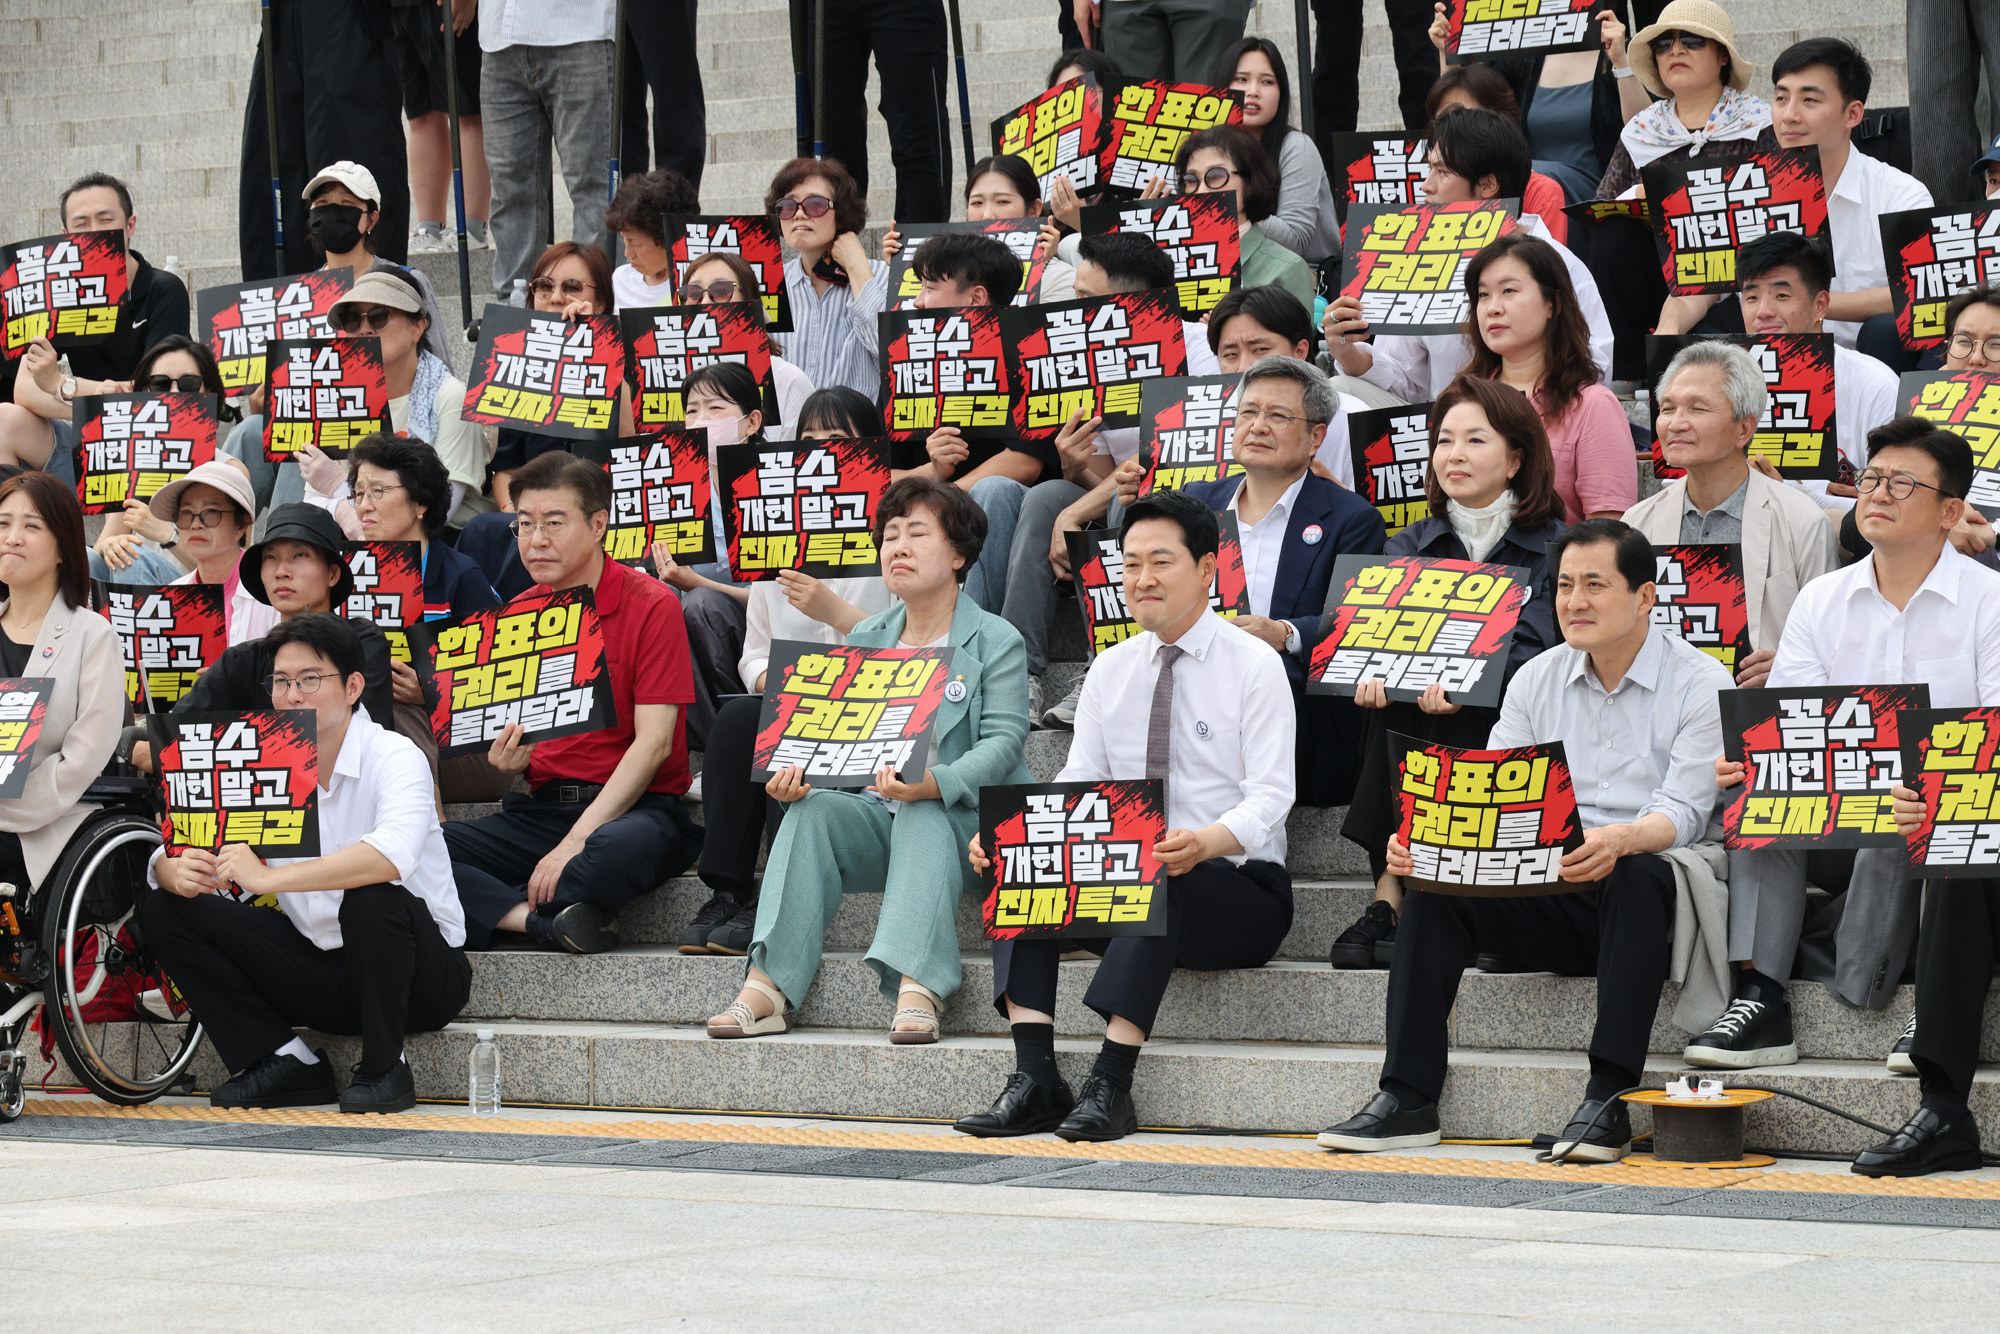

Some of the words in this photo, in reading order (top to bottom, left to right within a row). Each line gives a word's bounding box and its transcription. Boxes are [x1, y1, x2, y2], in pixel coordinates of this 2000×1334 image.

[1457, 12, 1589, 55] 돌려달라
[1002, 113, 1029, 156] 한
[1033, 84, 1085, 143] 표의
[1115, 85, 1156, 122] 한
[1156, 92, 1234, 130] 표의
[1117, 122, 1191, 163] 권리
[1110, 158, 1178, 194] 돌려
[1687, 162, 1769, 213] 꼼수
[1362, 213, 1418, 250] 한
[1418, 210, 1506, 251] 표의
[1670, 212, 1730, 249] 개헌
[1735, 203, 1803, 243] 말고
[16, 241, 82, 284] 꼼수
[1675, 249, 1736, 285] 진짜
[1910, 259, 1978, 299] 개헌
[4, 281, 45, 317] 개헌
[51, 275, 107, 308] 말고
[240, 282, 313, 326] 꼼수
[1360, 292, 1469, 324] 돌려달
[7, 312, 49, 349] 진짜
[57, 306, 118, 336] 특검
[219, 324, 275, 357] 개헌
[282, 315, 337, 339] 말고
[525, 319, 594, 362] 꼼수
[654, 314, 721, 356] 꼼수
[907, 316, 971, 360] 꼼수
[1046, 304, 1130, 355] 꼼수
[1913, 302, 1947, 338] 진
[288, 347, 341, 386] 꼼수
[493, 354, 556, 392] 개헌
[560, 362, 607, 396] 말고
[640, 357, 686, 389] 개헌
[893, 361, 933, 394] 개헌
[939, 359, 997, 392] 말고
[1026, 353, 1088, 391] 개헌
[1095, 344, 1162, 383] 말고
[102, 400, 169, 439] 꼼수
[275, 388, 311, 418] 개헌
[315, 388, 367, 418] 말고
[476, 385, 553, 423] 진짜
[556, 398, 613, 429] 특검
[893, 397, 937, 429] 진짜
[941, 395, 1010, 427] 특검
[1028, 388, 1095, 428] 진짜
[1104, 382, 1142, 415] 특
[1755, 393, 1811, 428] 고
[1912, 381, 1969, 421] 한
[85, 440, 128, 471] 개헌
[135, 440, 192, 469] 말고
[271, 422, 314, 451] 진짜
[319, 420, 381, 449] 특검
[1160, 429, 1215, 463] 개헌
[1390, 414, 1429, 461] 꼼
[1748, 432, 1824, 467] 특검
[610, 442, 673, 490] 꼼수
[758, 450, 838, 496] 꼼수
[1372, 461, 1428, 500] 개헌
[85, 472, 130, 504] 진짜
[135, 472, 187, 496] 특
[648, 482, 694, 520] 말고
[739, 497, 793, 532] 개헌
[802, 495, 868, 530] 말고
[652, 520, 704, 555] 특검
[740, 535, 798, 570] 진짜
[806, 532, 878, 566] 특검
[349, 551, 378, 592] 수
[1098, 539, 1123, 583] 꼼
[1656, 556, 1686, 602] 수
[348, 595, 402, 627] 말고
[1088, 586, 1130, 621] 개
[1343, 566, 1404, 605] 한
[1399, 569, 1513, 614] 표의
[109, 592, 174, 635] 꼼수
[1339, 609, 1484, 655] 권리를
[140, 636, 202, 668] 말고
[384, 632, 412, 662] 검
[436, 623, 482, 671] 한
[490, 602, 582, 660] 표의
[451, 653, 576, 711] 권리를
[783, 654, 846, 696] 한
[844, 659, 940, 699] 표의
[1320, 649, 1488, 692] 돌려달라
[450, 687, 594, 747] 돌려달라
[783, 698, 916, 740] 권리를
[1779, 697, 1874, 749] 꼼수
[179, 722, 259, 769] 꼼수
[766, 739, 917, 775] 돌려달라
[1923, 721, 1986, 771] 한
[166, 772, 213, 807] 개헌
[220, 771, 290, 807] 말고
[1402, 750, 1440, 798] 한
[1447, 757, 1549, 803] 표의
[1752, 751, 1824, 791] 개헌
[1834, 750, 1903, 790] 말고
[169, 813, 217, 847] 진짜
[225, 810, 305, 845] 특검
[1025, 792, 1111, 843] 꼼수
[1410, 799, 1541, 848] 권리를
[1740, 797, 1829, 835] 진짜
[1001, 845, 1063, 883] 개헌
[1072, 844, 1140, 882] 말고
[1409, 842, 1564, 885] 돌려달라
[995, 888, 1068, 926] 진짜
[1076, 885, 1154, 922] 특검
